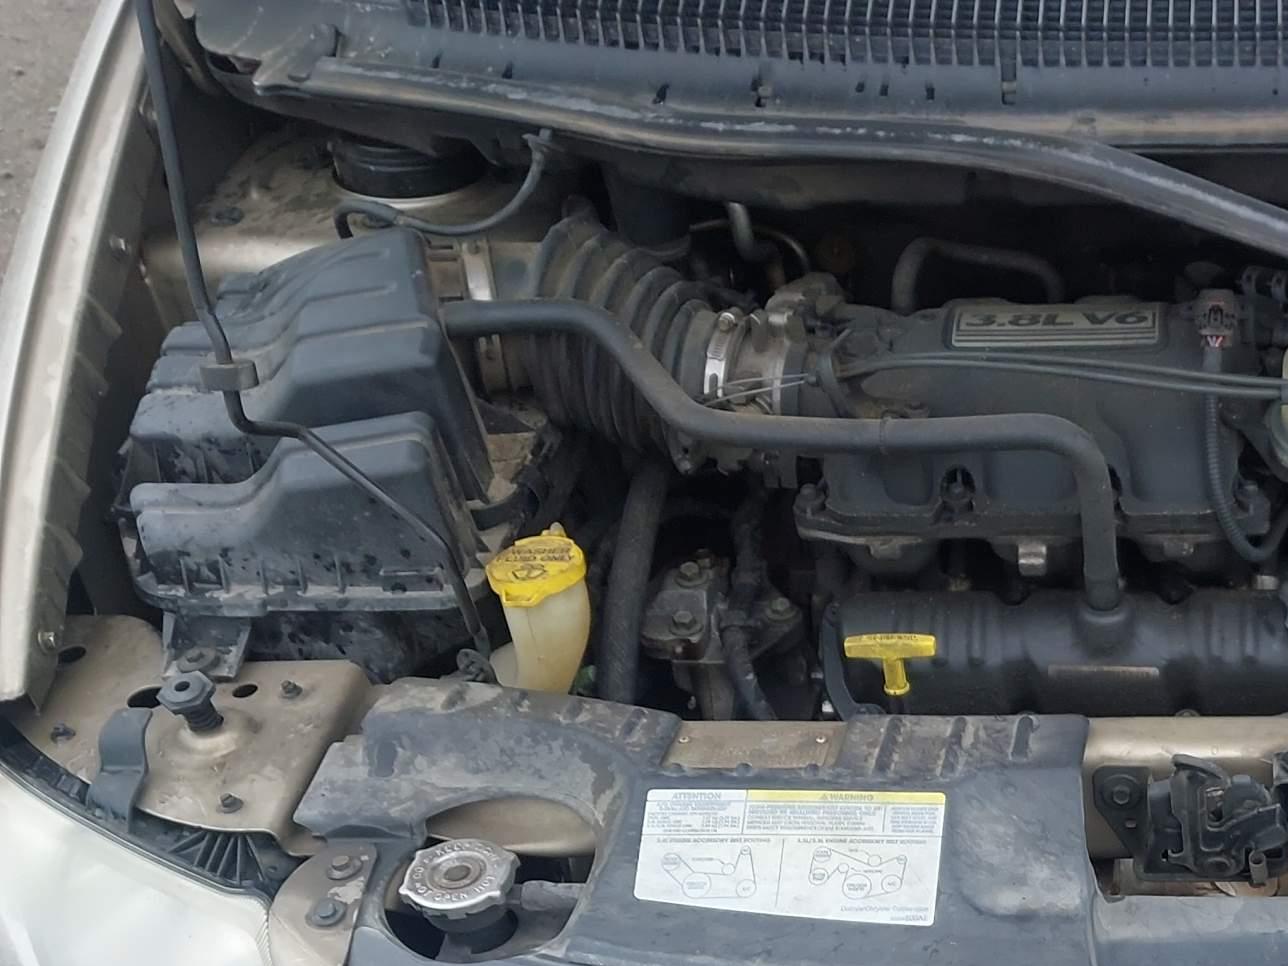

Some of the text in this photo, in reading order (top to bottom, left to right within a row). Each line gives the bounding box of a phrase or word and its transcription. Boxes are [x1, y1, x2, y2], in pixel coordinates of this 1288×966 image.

[965, 311, 1149, 328] 3.8L V6
[511, 547, 571, 555] WASHER
[496, 553, 575, 562] FLUID ONLY
[672, 791, 722, 801] ATTENTION
[829, 793, 875, 802] WARNING
